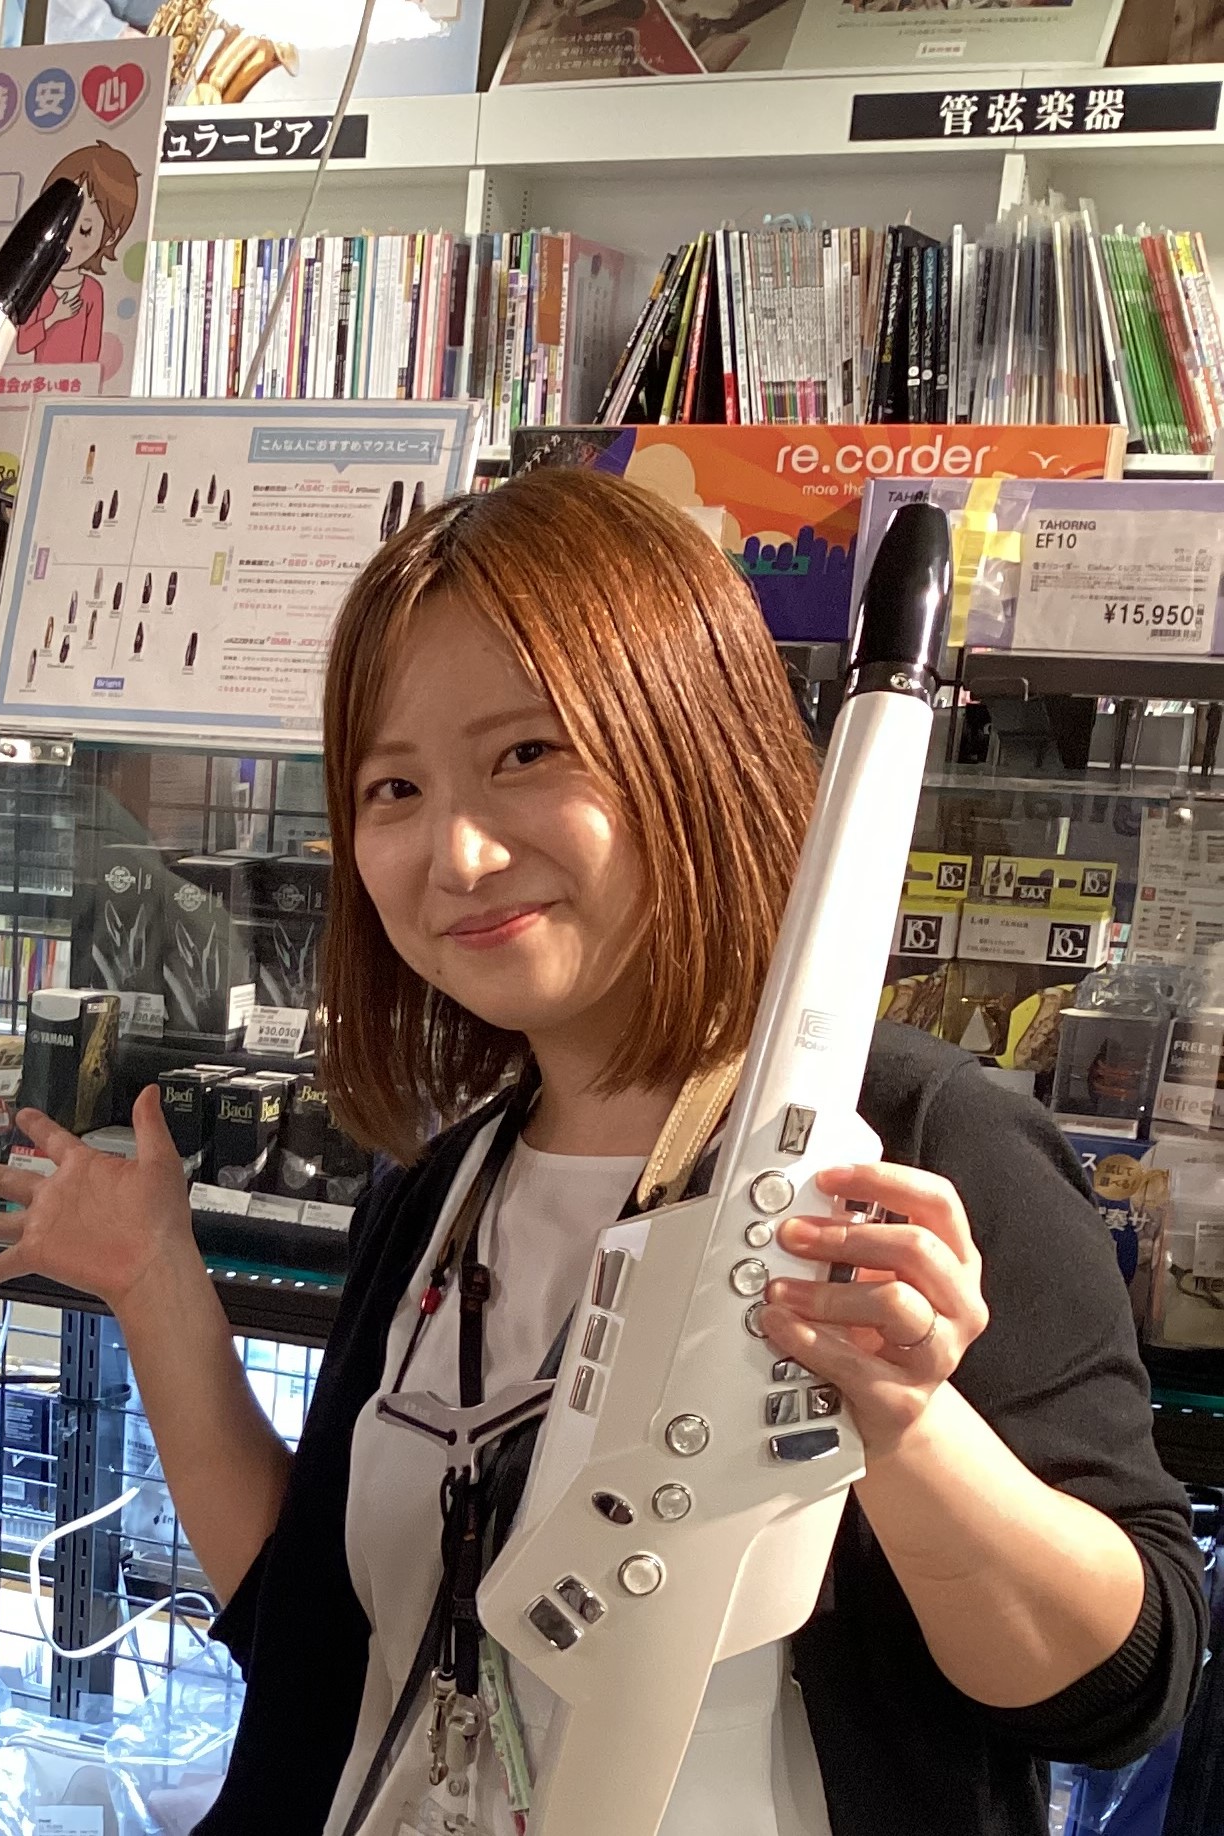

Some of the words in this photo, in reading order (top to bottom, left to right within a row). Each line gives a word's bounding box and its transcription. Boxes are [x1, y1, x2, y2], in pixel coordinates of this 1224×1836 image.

[939, 89, 1127, 136] 管弦楽器
[160, 119, 334, 158] ュラーピアノ
[261, 438, 430, 453] こんな人におすすめマウスピース
[776, 435, 992, 475] re.corder
[802, 484, 838, 496] more
[1039, 519, 1097, 531] TAHORNG
[1035, 533, 1077, 549] EF10
[1104, 602, 1194, 626] ¥15,950
[1019, 887, 1046, 900] SAX
[40, 1032, 74, 1047] YAMAHA
[164, 1086, 194, 1103] Bach
[218, 1099, 254, 1120] Bach
[261, 1096, 281, 1122] Bach
[1099, 1207, 1151, 1232] 奏サ
